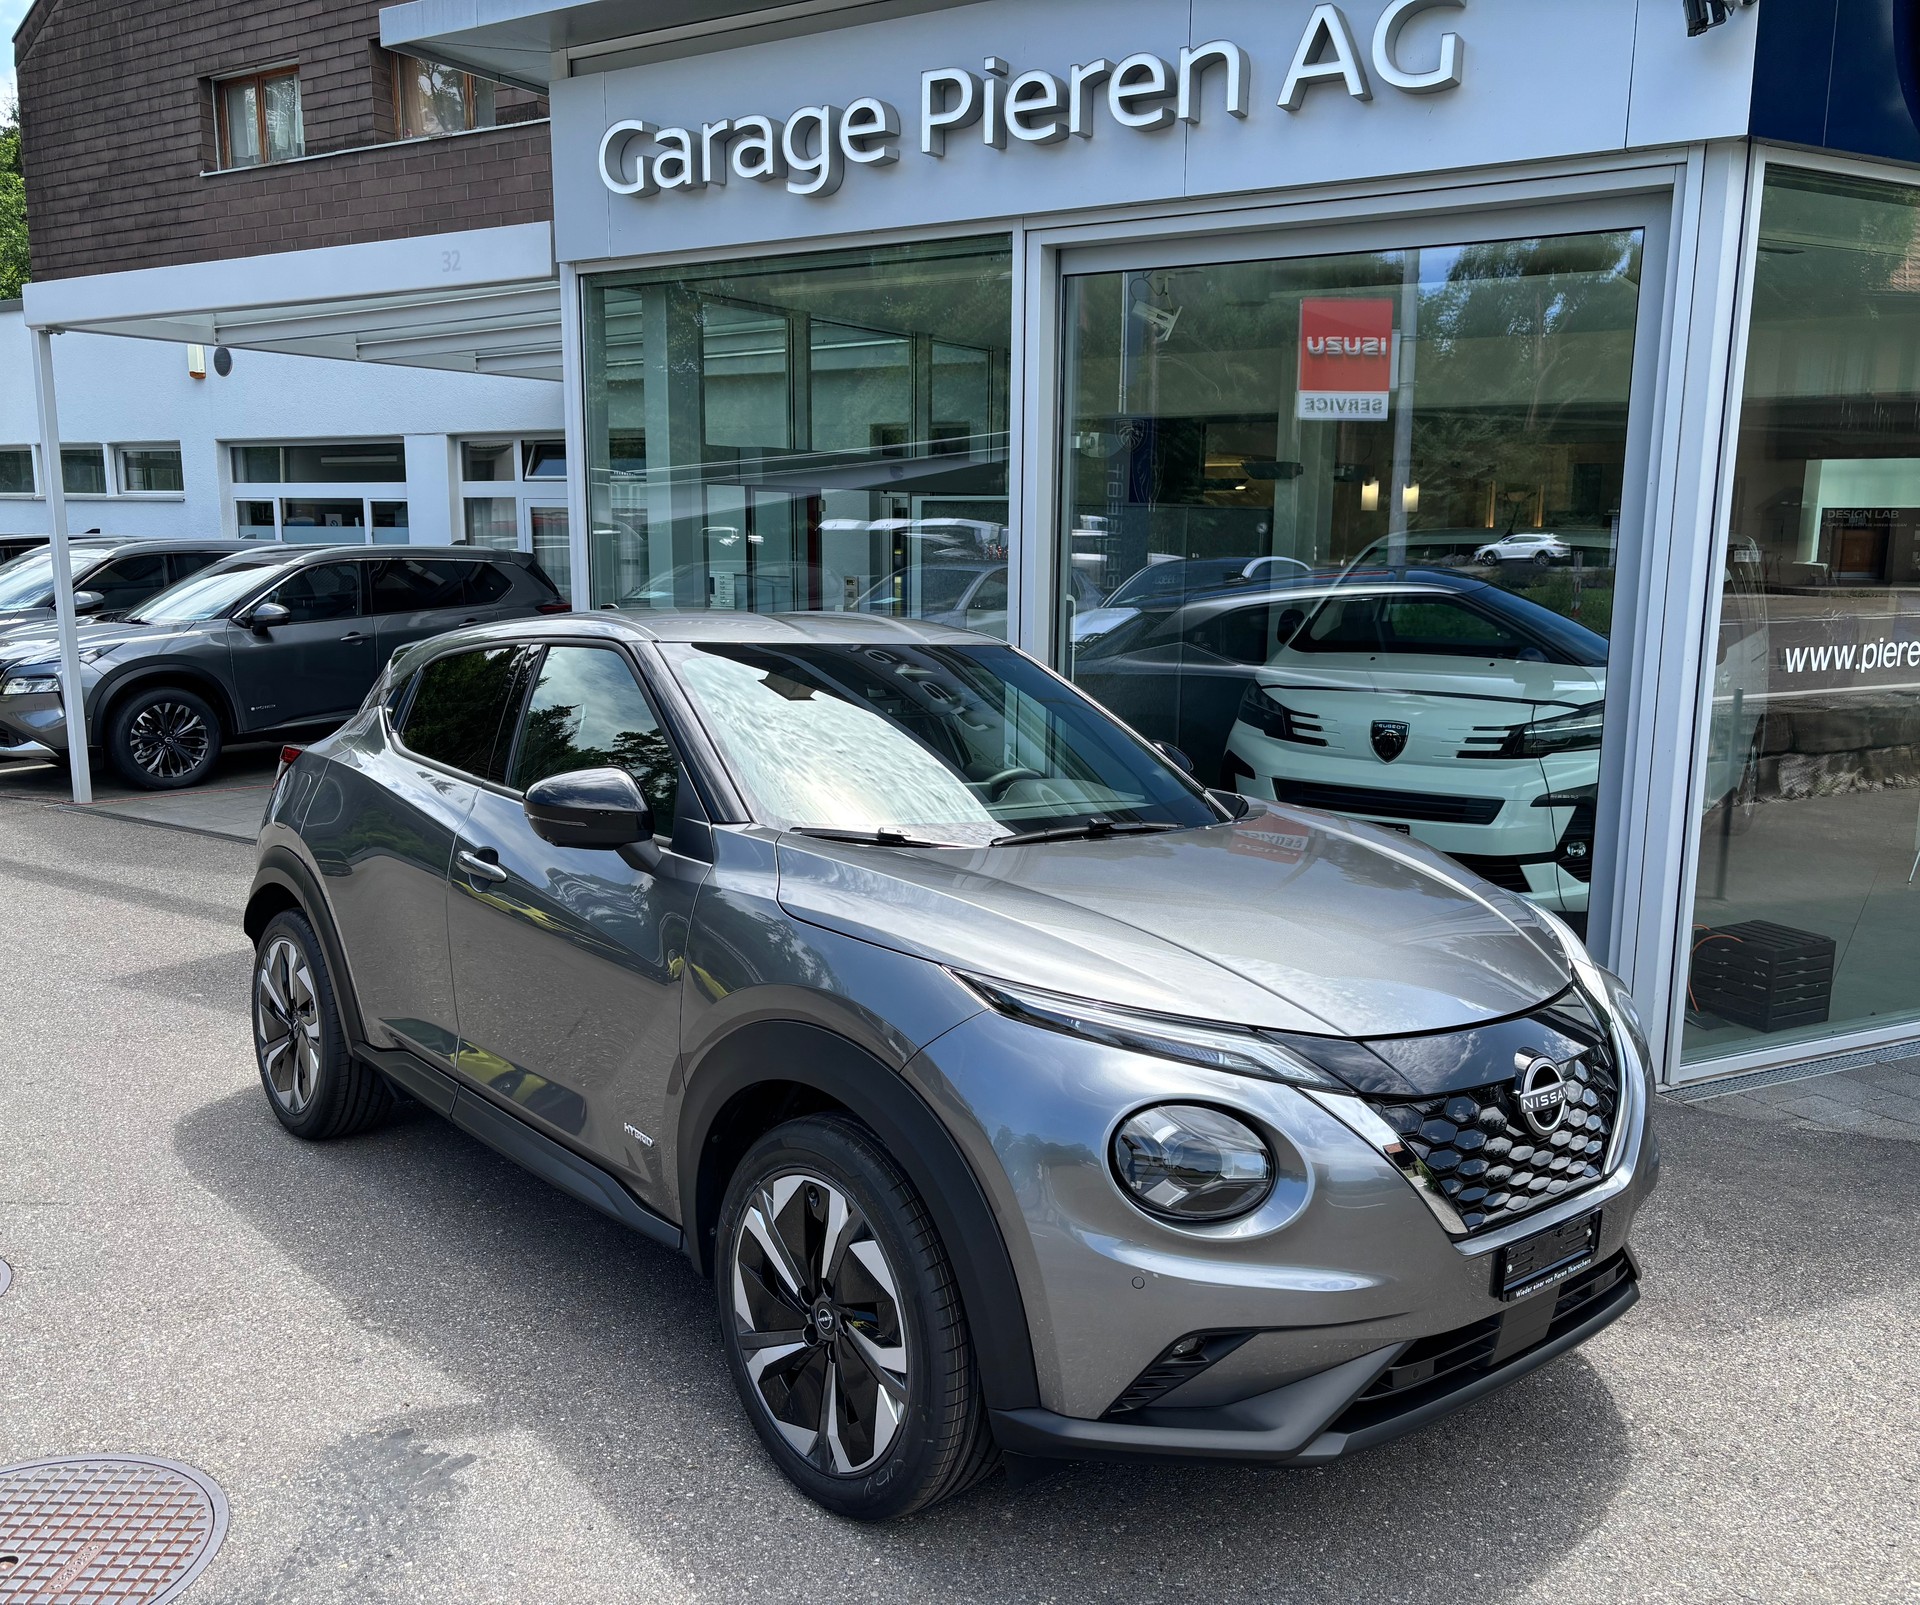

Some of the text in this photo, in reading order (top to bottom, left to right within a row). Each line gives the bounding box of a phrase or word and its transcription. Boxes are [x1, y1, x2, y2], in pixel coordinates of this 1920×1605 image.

[598, 0, 1465, 197] Garage Pieren AG
[441, 250, 461, 272] 32
[1827, 510, 1899, 519] DESIGN LAB
[1785, 637, 1920, 673] www.piere
[1522, 1085, 1568, 1110] NISSAN
[1515, 1286, 1532, 1298] Wieder
[1533, 1280, 1544, 1290] einer
[1545, 1277, 1553, 1285] von
[1554, 1270, 1567, 1280] Pieren
